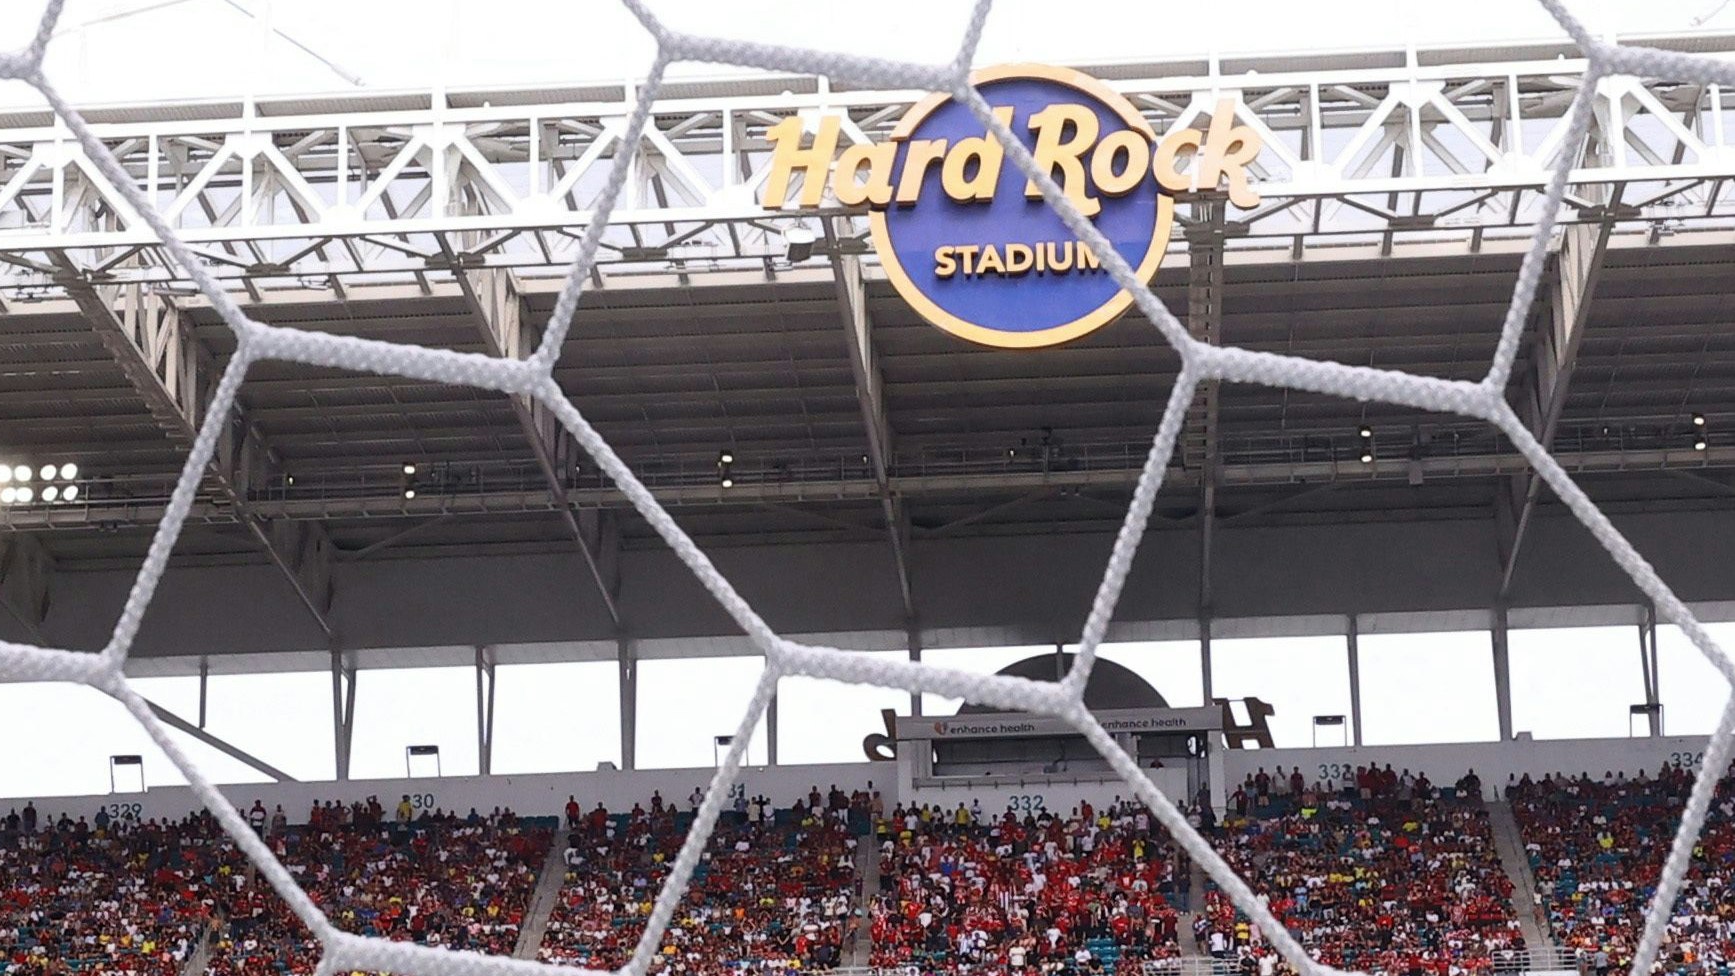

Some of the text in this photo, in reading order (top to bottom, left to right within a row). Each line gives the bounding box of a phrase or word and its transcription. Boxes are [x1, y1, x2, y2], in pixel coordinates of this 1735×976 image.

[762, 97, 1262, 217] Hard Rock
[934, 241, 1106, 279] STADIUM
[950, 721, 1036, 735] enhance health
[1151, 715, 1187, 728] health
[1009, 795, 1044, 810] 332
